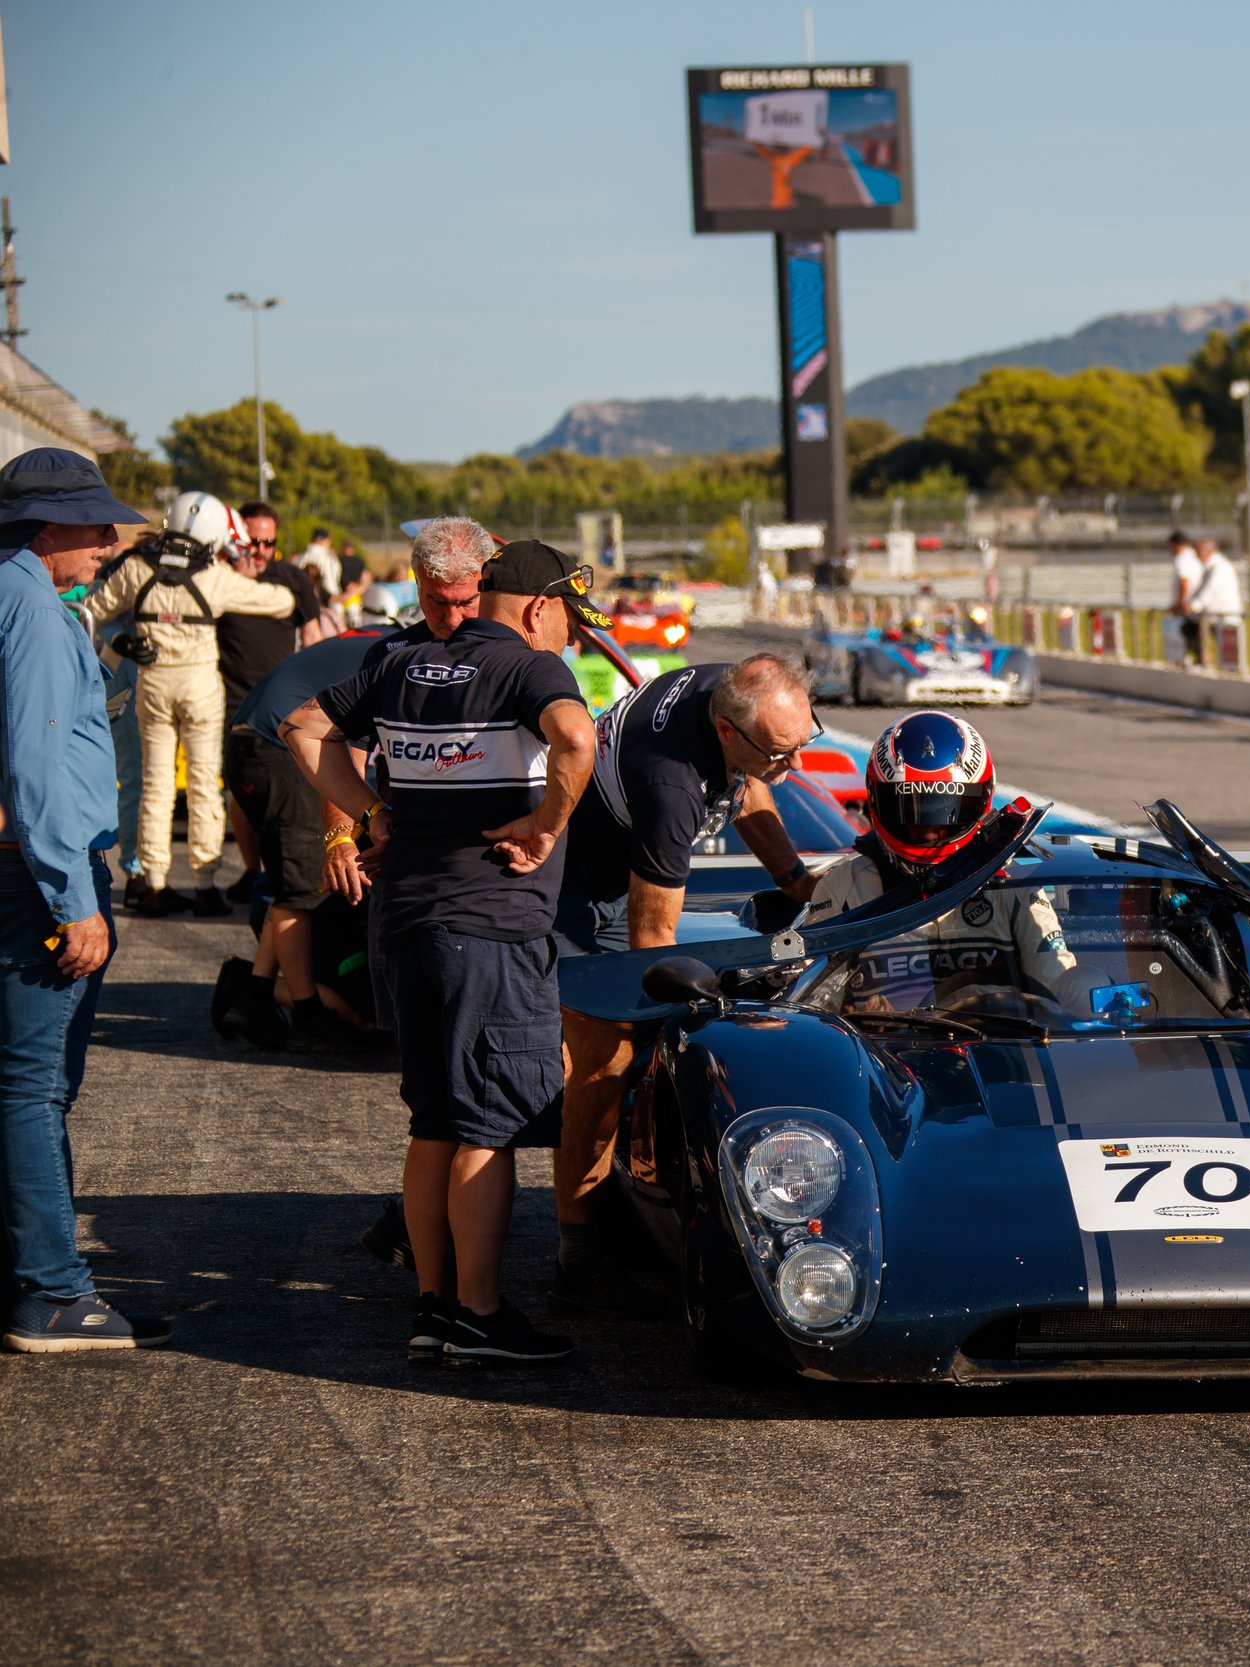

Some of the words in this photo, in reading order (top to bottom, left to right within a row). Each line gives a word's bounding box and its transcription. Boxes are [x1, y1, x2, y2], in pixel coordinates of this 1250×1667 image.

[813, 67, 876, 88] MILLE
[387, 739, 475, 761] LEGACY
[895, 781, 965, 795] KENWOOD
[965, 901, 991, 921] TIGA
[868, 949, 998, 979] LEGACY
